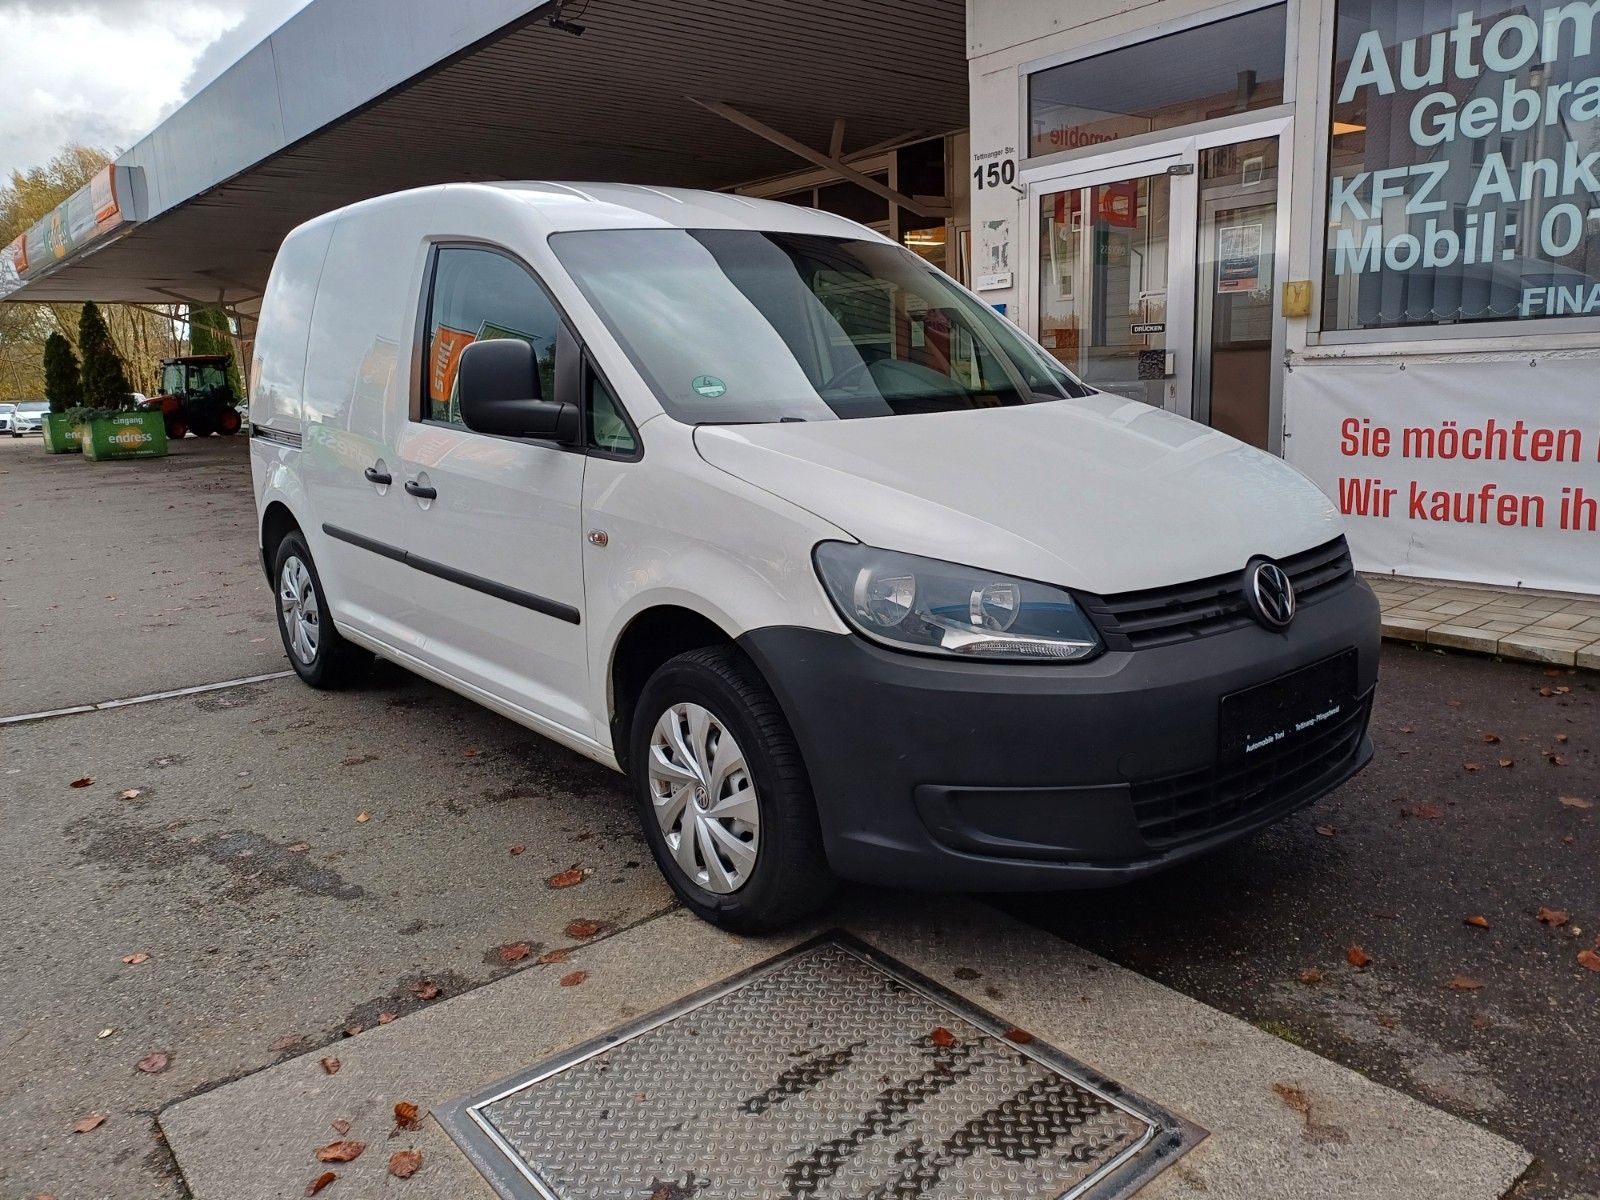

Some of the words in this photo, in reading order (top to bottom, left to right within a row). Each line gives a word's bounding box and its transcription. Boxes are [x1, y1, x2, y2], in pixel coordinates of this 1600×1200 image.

[1409, 77, 1600, 147] Gebra
[974, 159, 1015, 190] 150
[1331, 160, 1450, 221] KFZ
[1467, 141, 1600, 207] Ank
[1335, 211, 1517, 276] Mobil:
[1540, 203, 1600, 257] 0
[1134, 325, 1163, 333] DRÜCKEN
[434, 339, 456, 393] STIHL
[108, 432, 152, 444] endress
[1341, 418, 1390, 457] Sie
[1403, 419, 1582, 462] möchten
[1339, 478, 1397, 517] Wir
[1409, 481, 1544, 528] kaufen
[1560, 487, 1597, 531] ih
